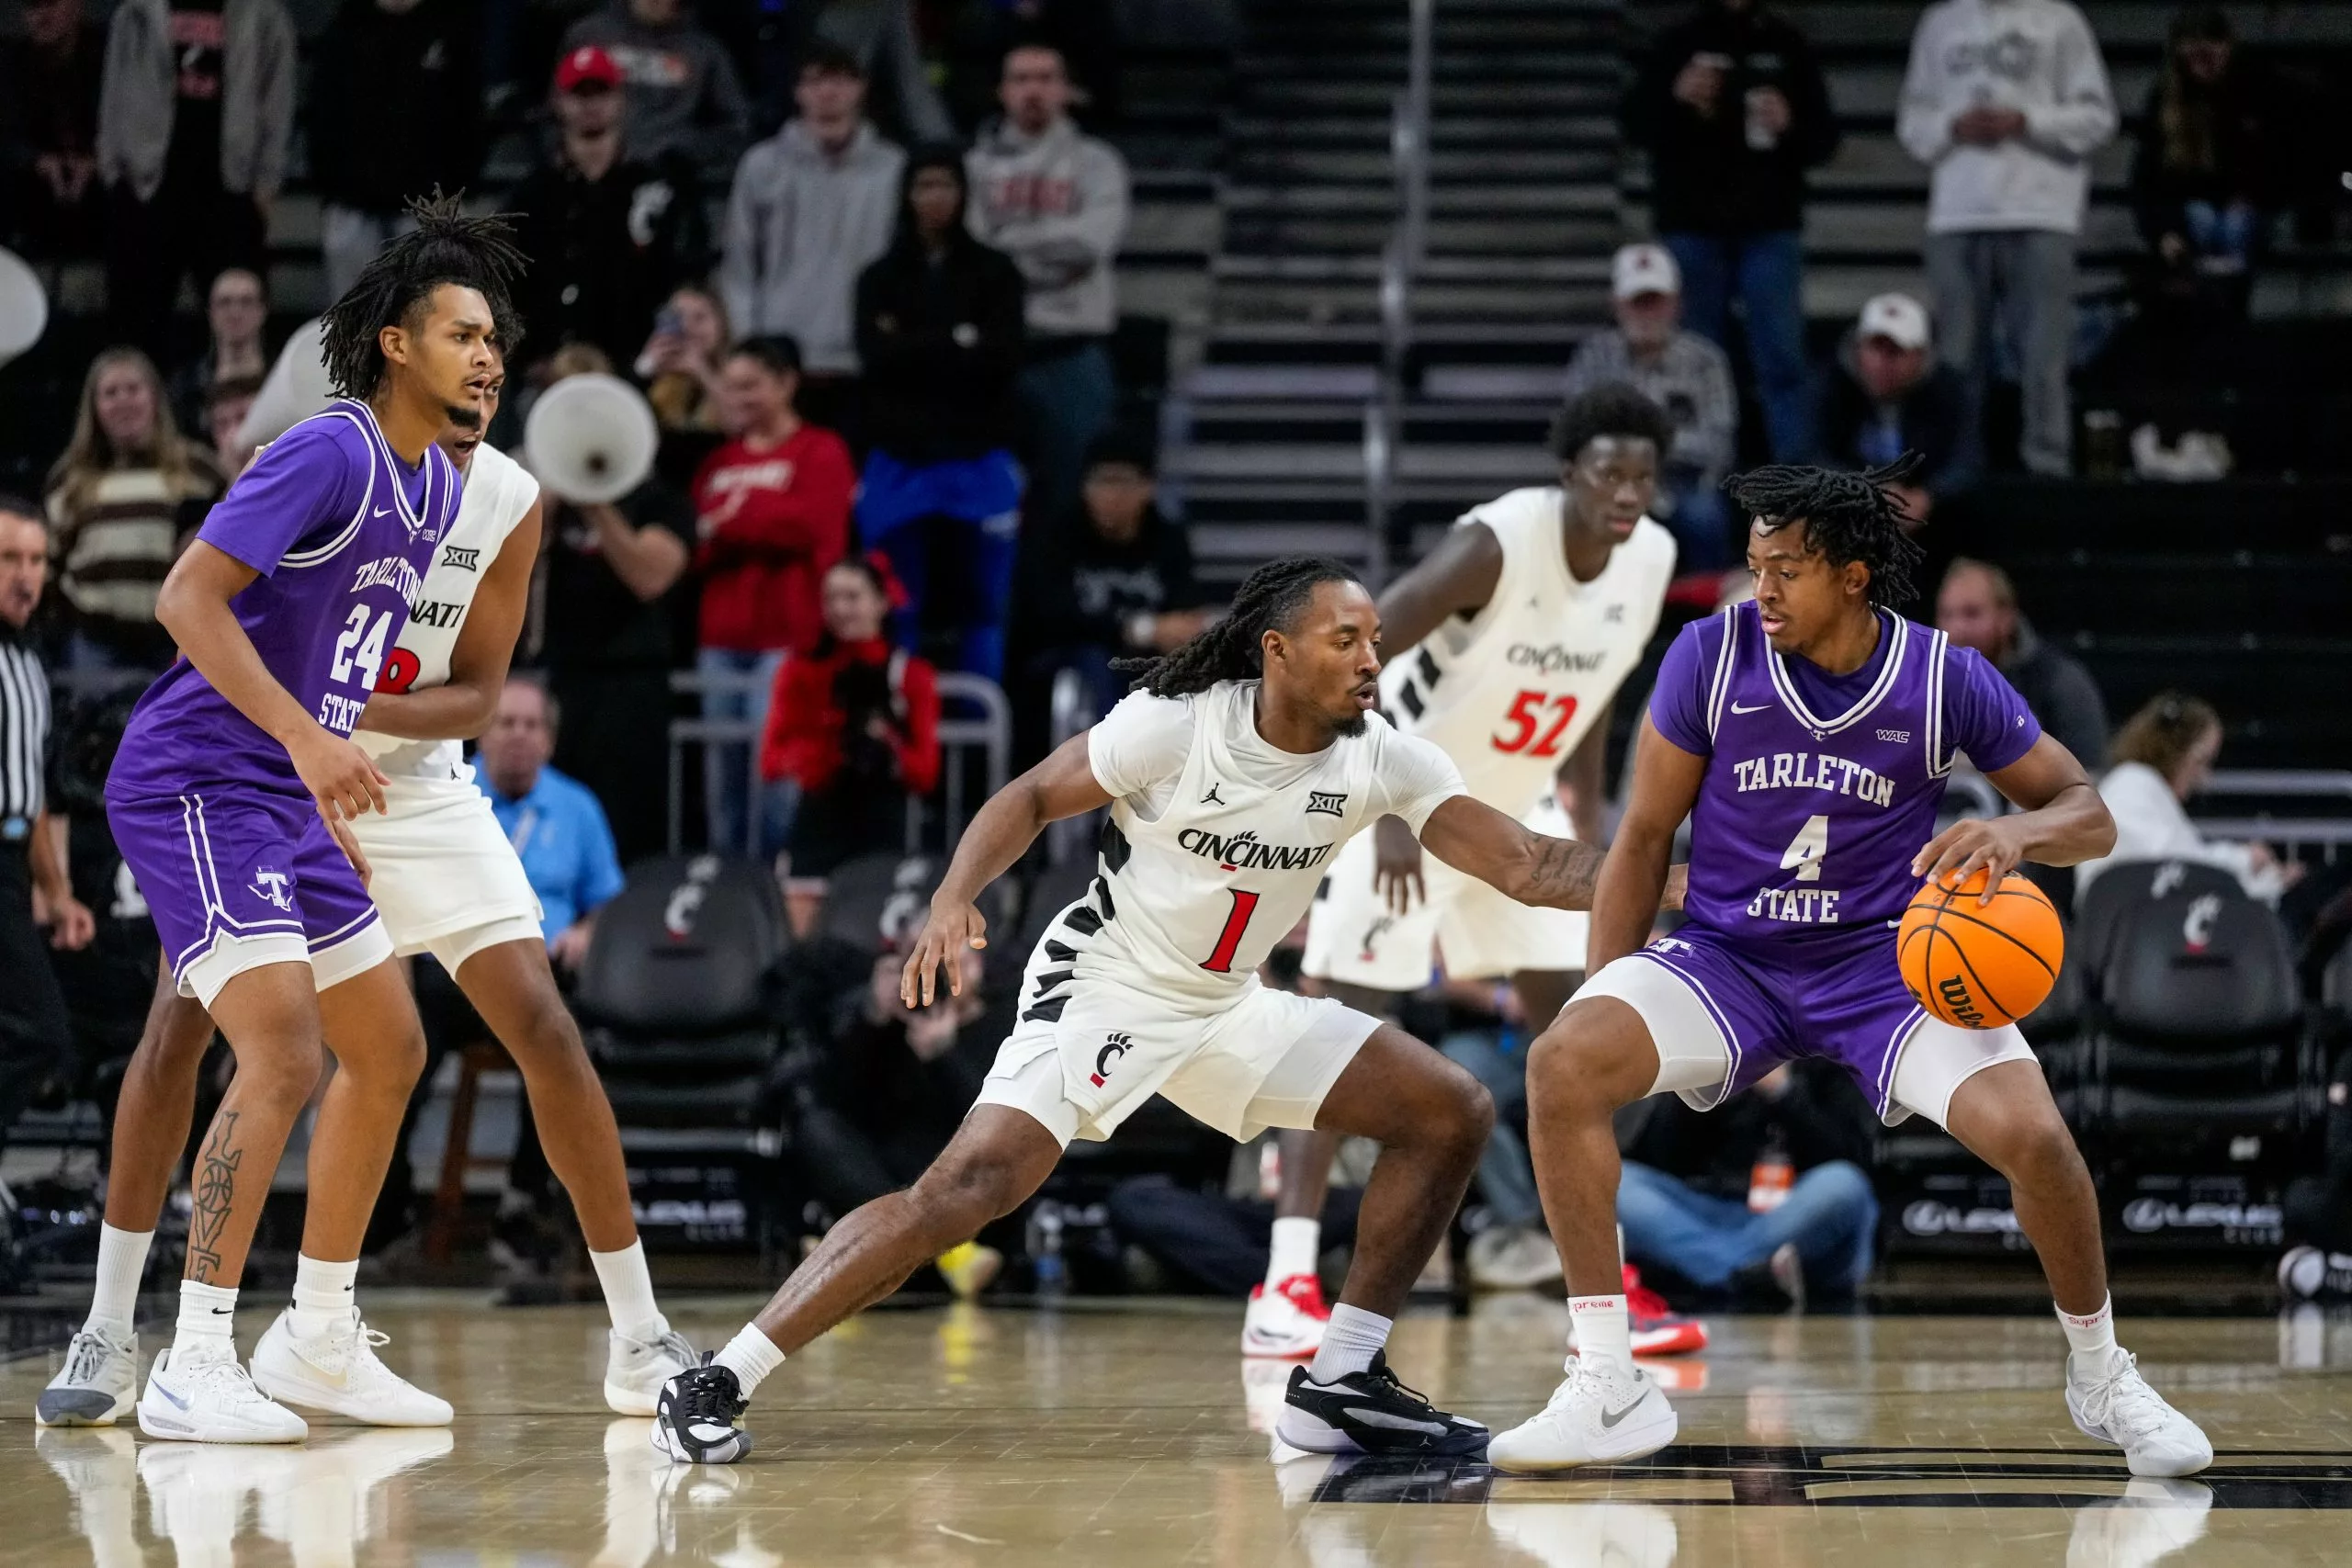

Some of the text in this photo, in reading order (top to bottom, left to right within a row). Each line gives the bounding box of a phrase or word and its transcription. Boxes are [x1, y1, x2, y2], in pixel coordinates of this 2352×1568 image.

[442, 545, 480, 572] XII
[330, 603, 393, 692] 24
[1492, 690, 1578, 758] 52
[1876, 729, 1910, 743] WAC
[1734, 752, 1895, 807] TARLETON
[1306, 791, 1348, 818] XII
[1178, 829, 1335, 870] CINCINNATI
[1780, 815, 1828, 881] 4
[1747, 887, 1839, 923] STATE
[1198, 887, 1260, 973] 1
